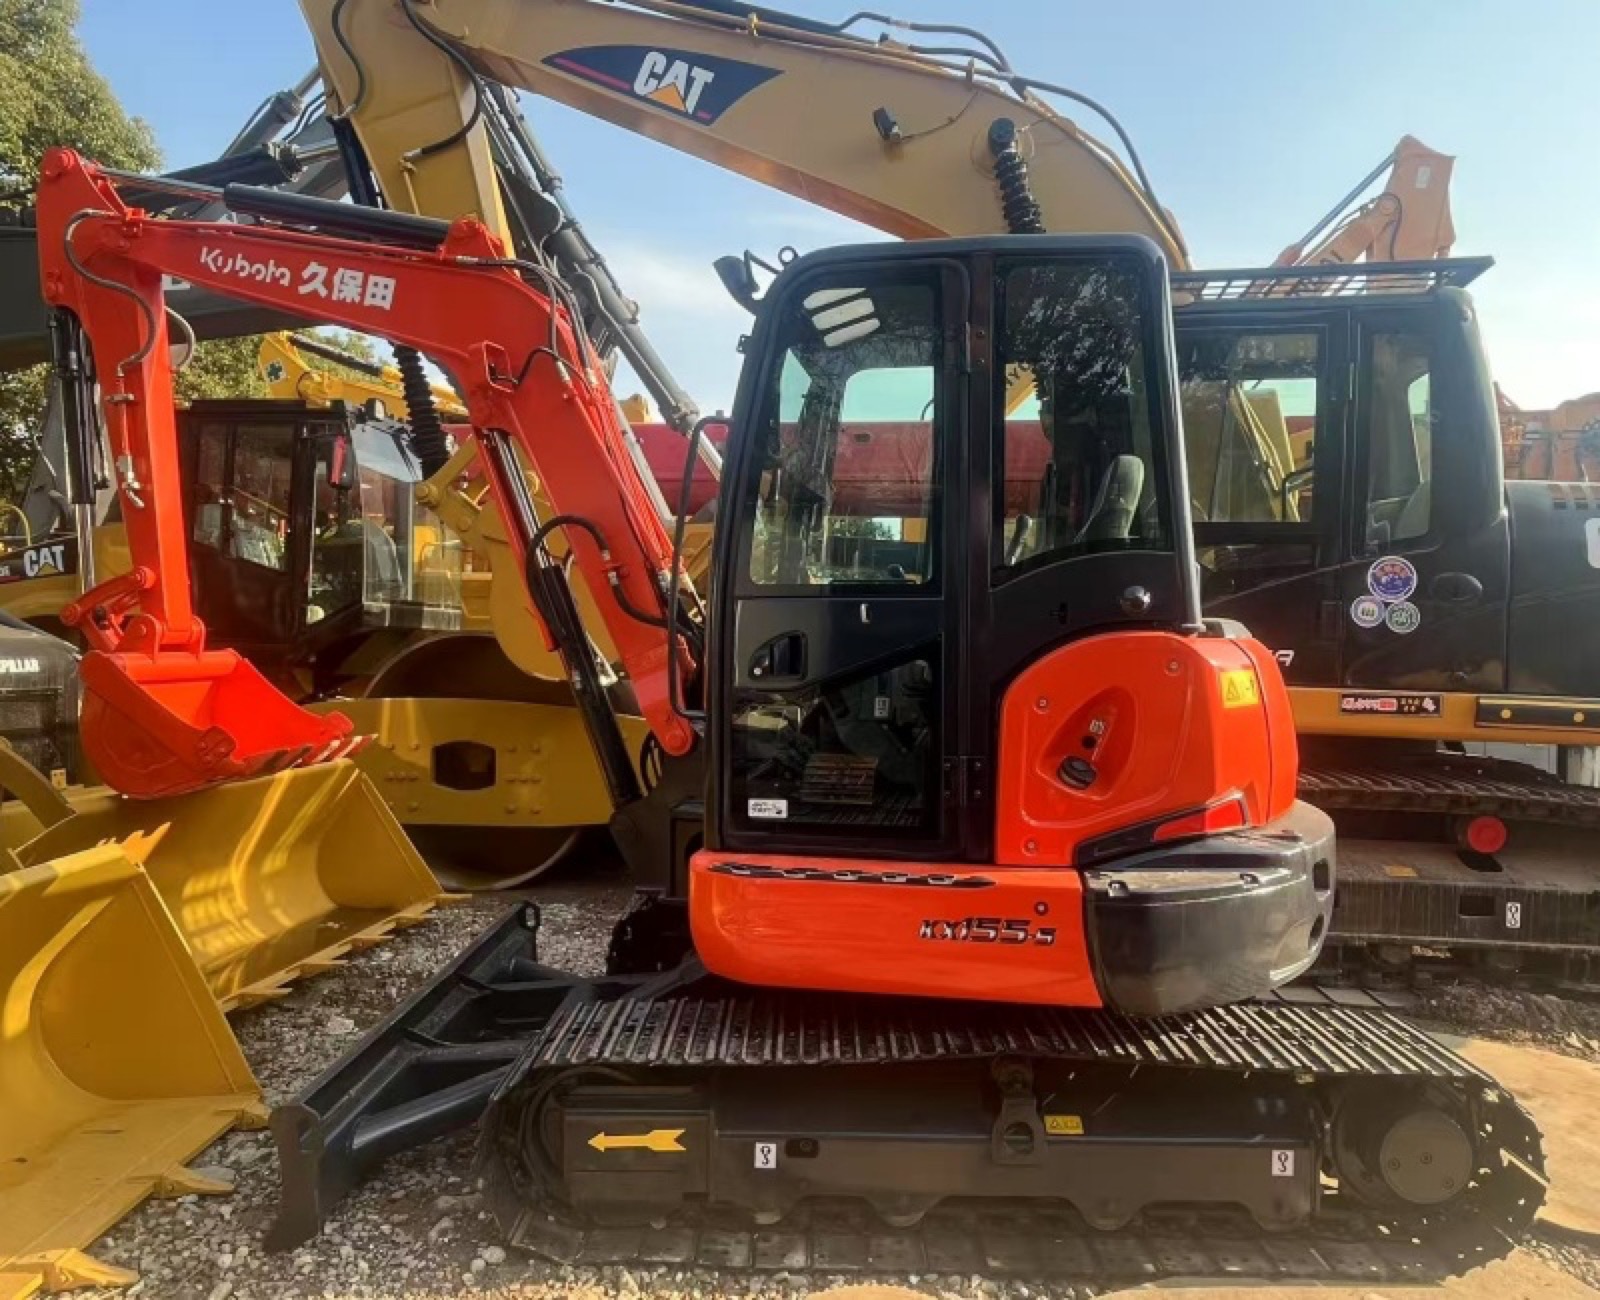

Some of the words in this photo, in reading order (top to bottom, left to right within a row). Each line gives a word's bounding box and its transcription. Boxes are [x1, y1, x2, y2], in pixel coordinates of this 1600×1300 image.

[633, 51, 715, 115] CAT
[298, 262, 396, 310] 久保田
[24, 545, 65, 577] CAT
